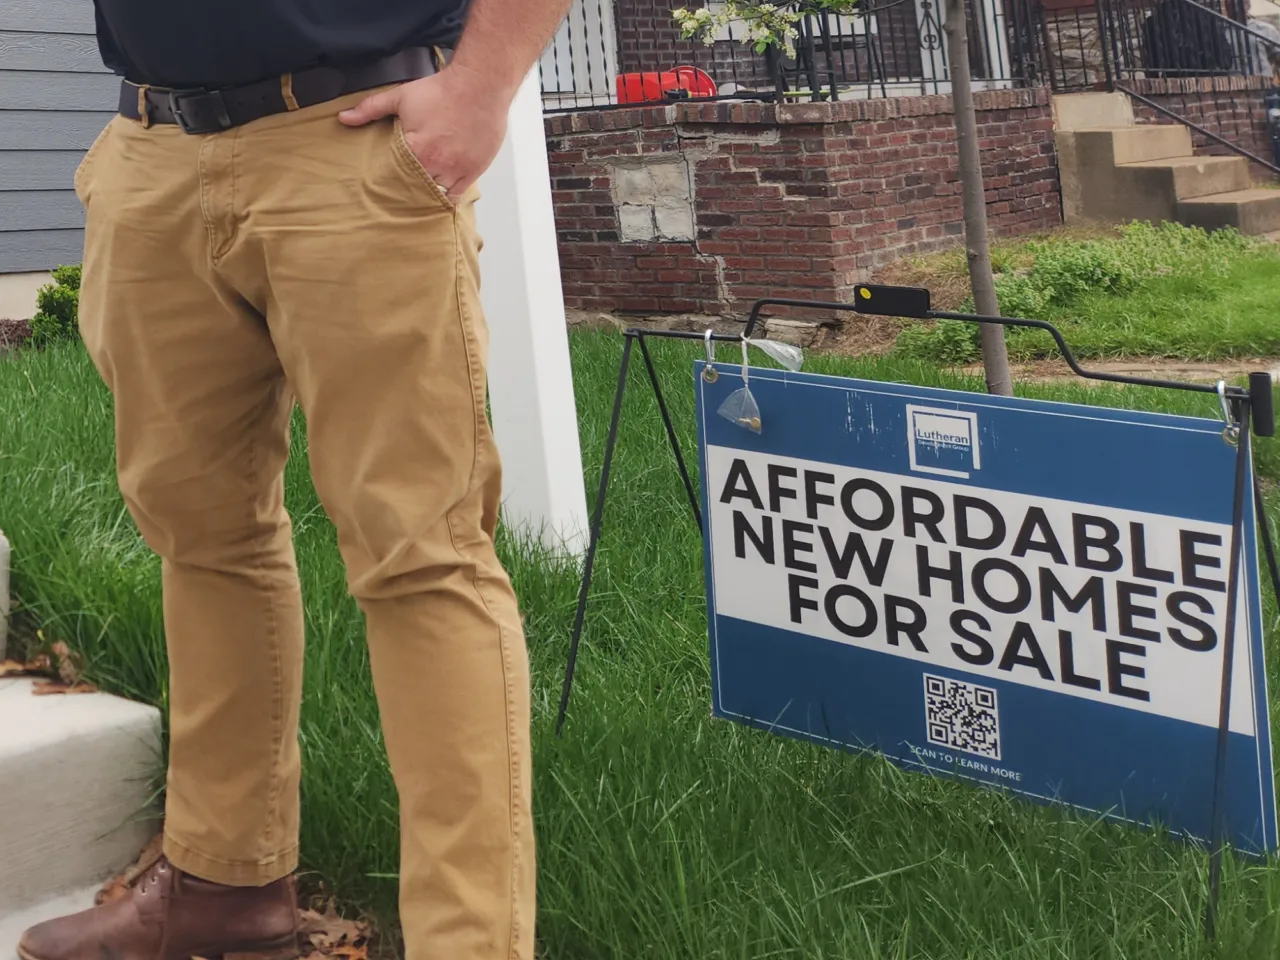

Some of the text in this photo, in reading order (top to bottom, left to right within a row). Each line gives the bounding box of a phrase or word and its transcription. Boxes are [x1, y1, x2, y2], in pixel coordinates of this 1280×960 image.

[917, 428, 969, 444] Lutheran
[918, 440, 970, 452] Develoment Group
[720, 458, 1227, 592] AFFORDABLE
[732, 510, 1218, 652] NEW HOMES
[788, 573, 1150, 702] FOR SALE
[910, 745, 1022, 781] SCAN TO LEARN MORE
